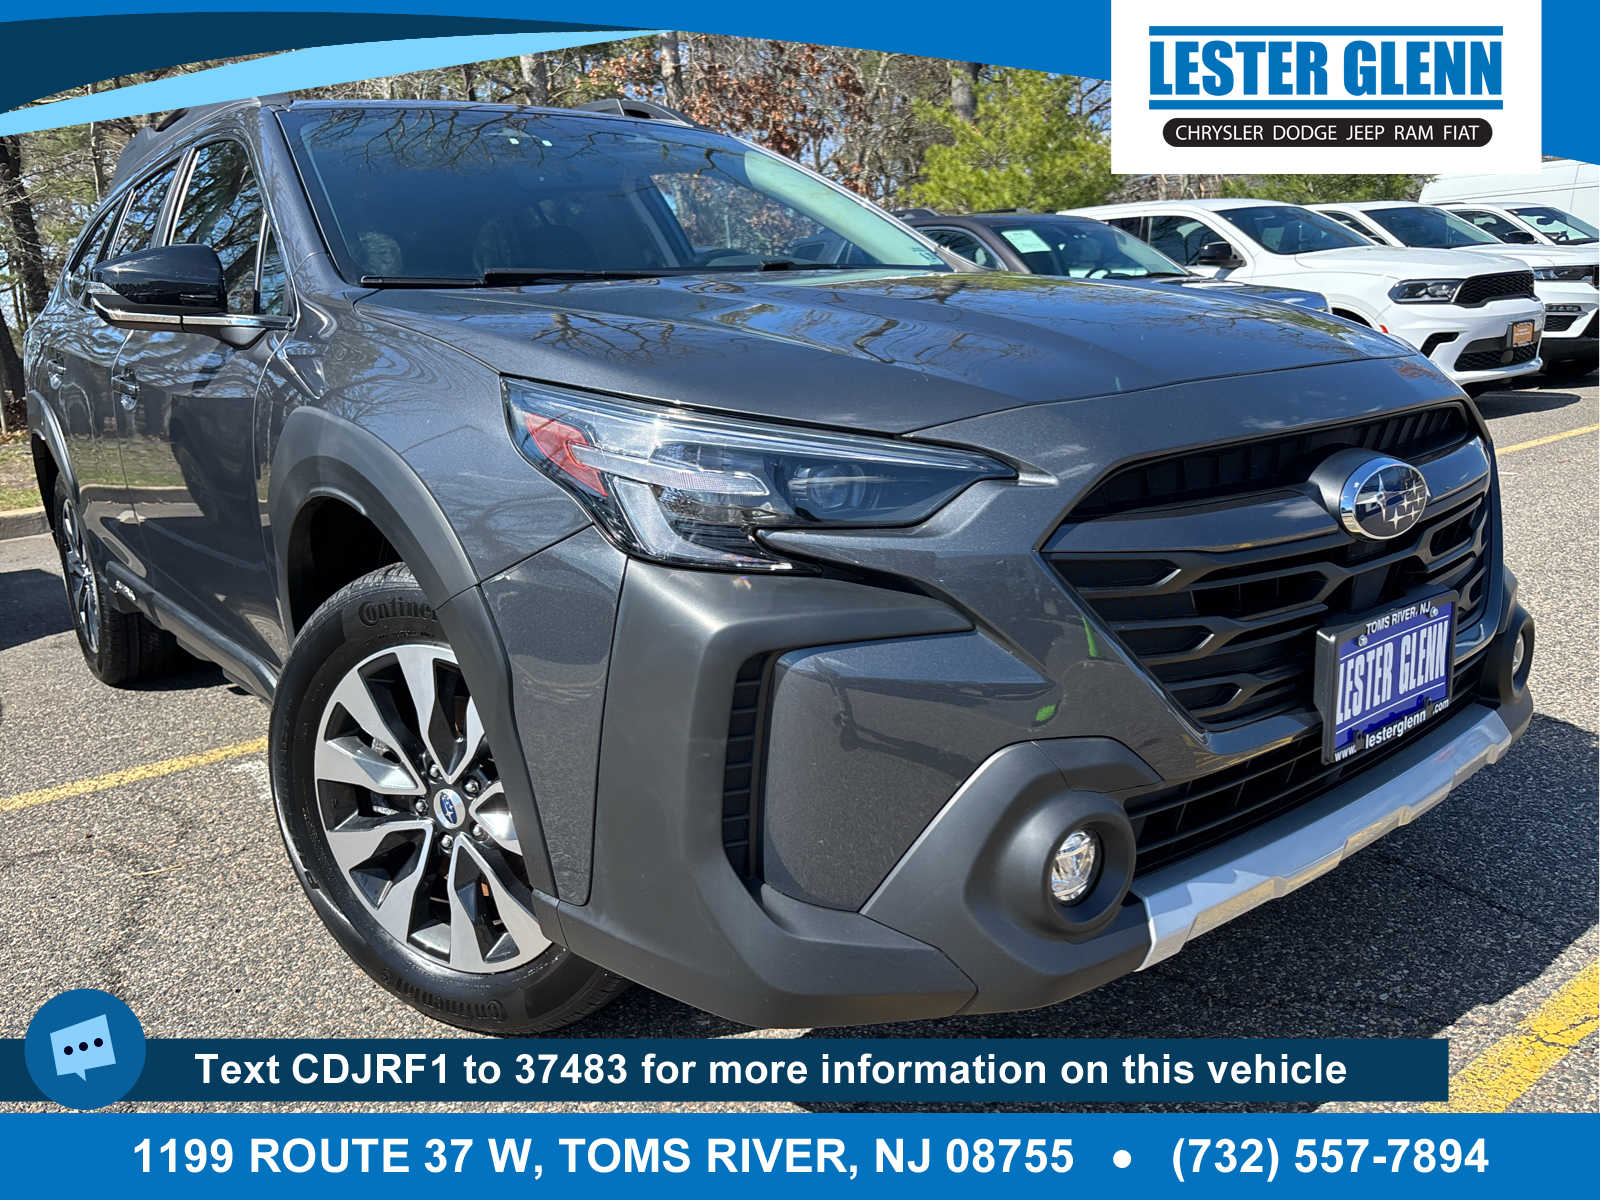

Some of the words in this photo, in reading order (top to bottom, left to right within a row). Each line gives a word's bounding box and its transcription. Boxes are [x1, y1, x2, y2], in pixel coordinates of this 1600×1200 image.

[1365, 615, 1390, 635] TOMS
[1419, 601, 1431, 615] NJ
[1335, 641, 1394, 726] LESTER
[1399, 620, 1449, 695] GLENN
